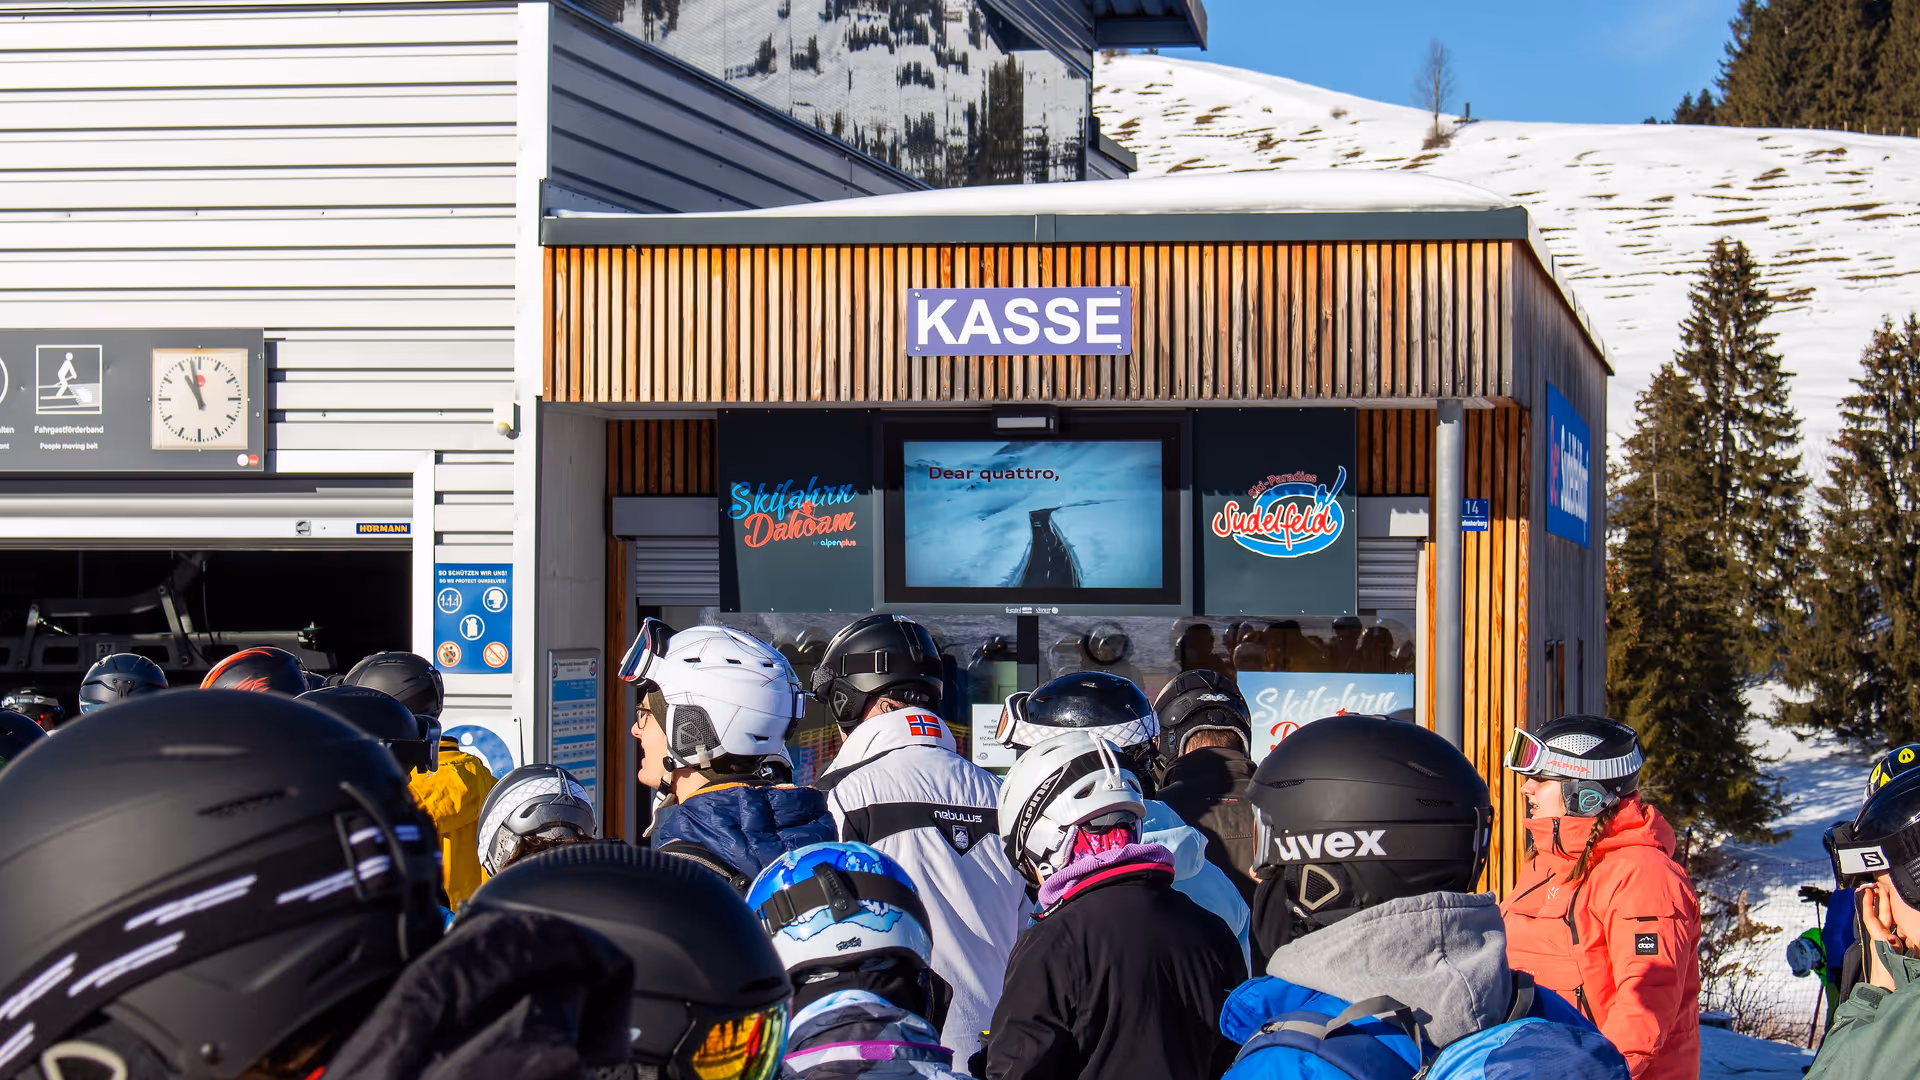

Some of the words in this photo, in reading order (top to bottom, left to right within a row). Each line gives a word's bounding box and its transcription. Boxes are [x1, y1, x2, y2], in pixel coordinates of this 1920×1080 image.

[917, 297, 1122, 345] KASSE
[34, 425, 104, 435] Fahrgastförderband
[39, 442, 61, 451] People
[62, 442, 85, 451] moving
[86, 442, 98, 450] belt
[928, 466, 974, 480] Dear
[980, 468, 1060, 482] quattro,
[1247, 470, 1317, 500] Ski-Paradies
[727, 475, 857, 521] Skifahrn
[1465, 500, 1479, 515] 14
[743, 509, 857, 548] Dahoam
[1211, 500, 1338, 551] Sudelfeld
[820, 538, 857, 549] alpenplus
[1544, 759, 1592, 775] ALPINA
[1017, 770, 1062, 849] ALPINA
[1274, 829, 1388, 861] uvex
